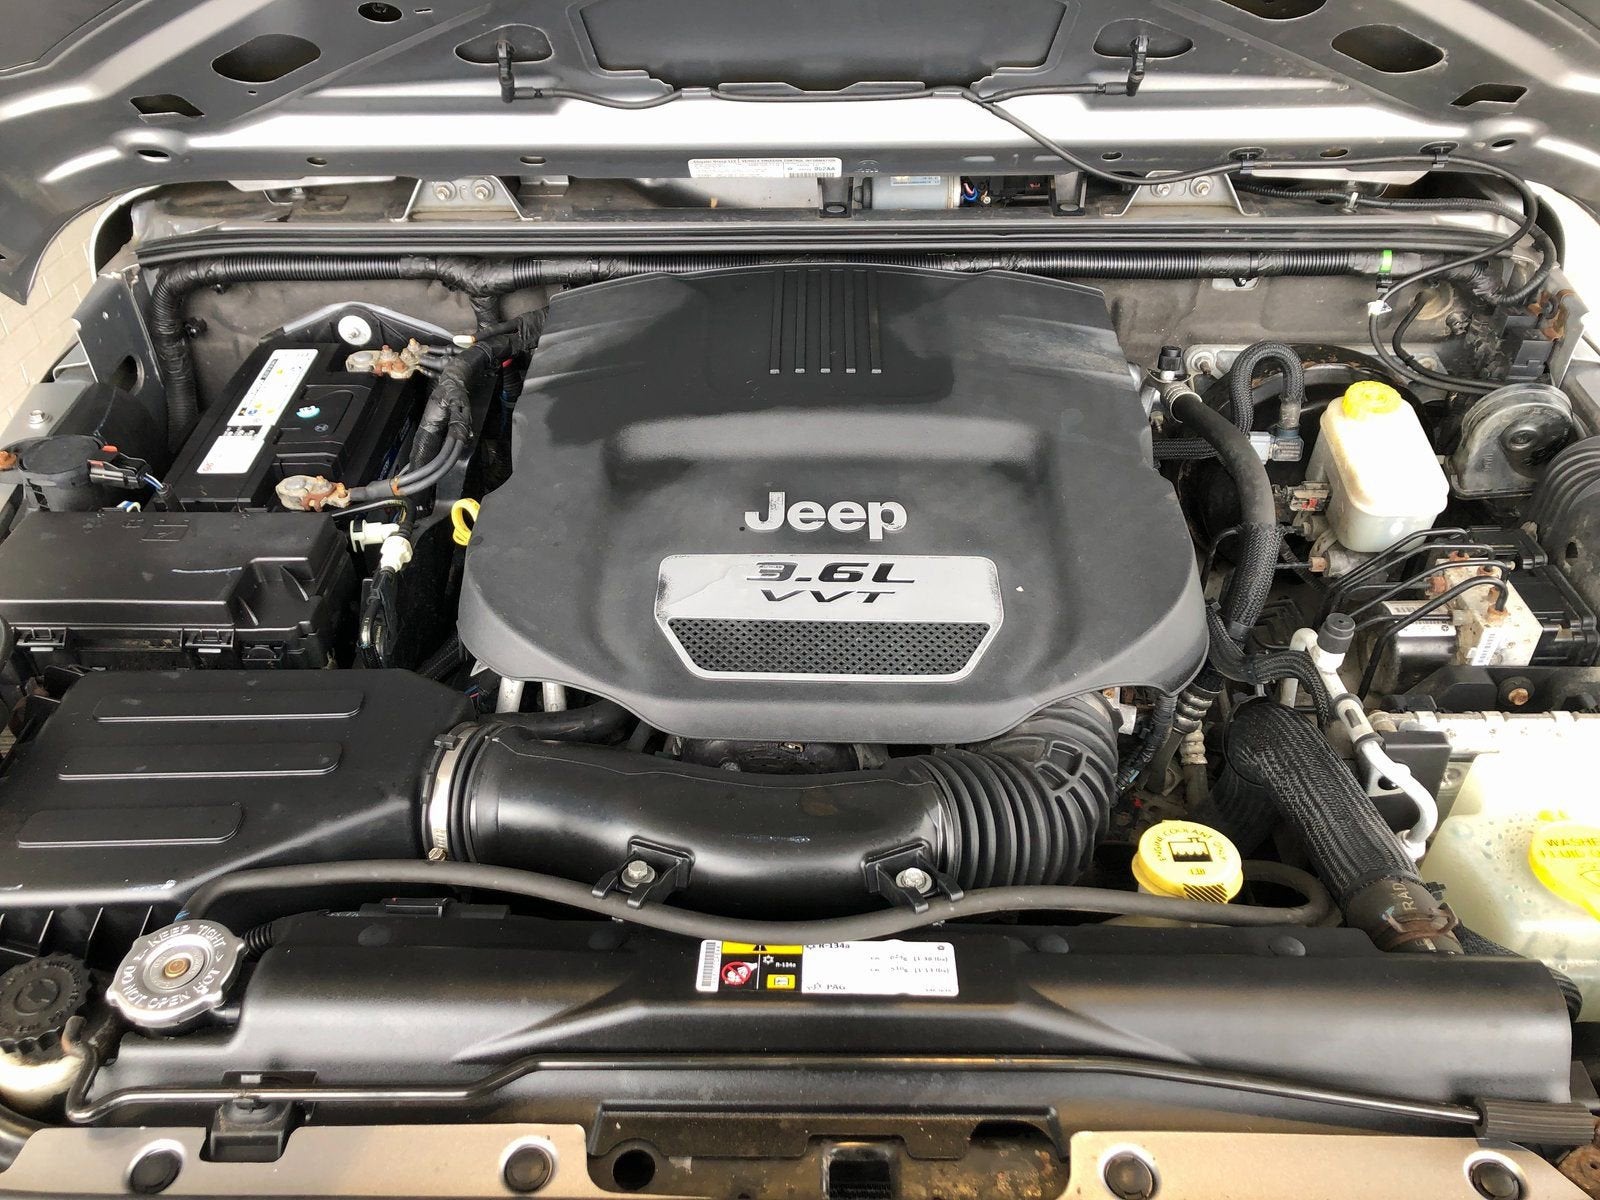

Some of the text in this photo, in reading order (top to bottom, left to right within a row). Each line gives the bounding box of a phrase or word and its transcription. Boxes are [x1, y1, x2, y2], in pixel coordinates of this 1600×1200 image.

[744, 491, 908, 540] Jeep
[746, 562, 915, 584] 3.6L
[760, 589, 896, 604] VVT
[147, 924, 226, 948] KEEP TIGHT
[121, 965, 220, 1009] DO NOT OPEN HOT
